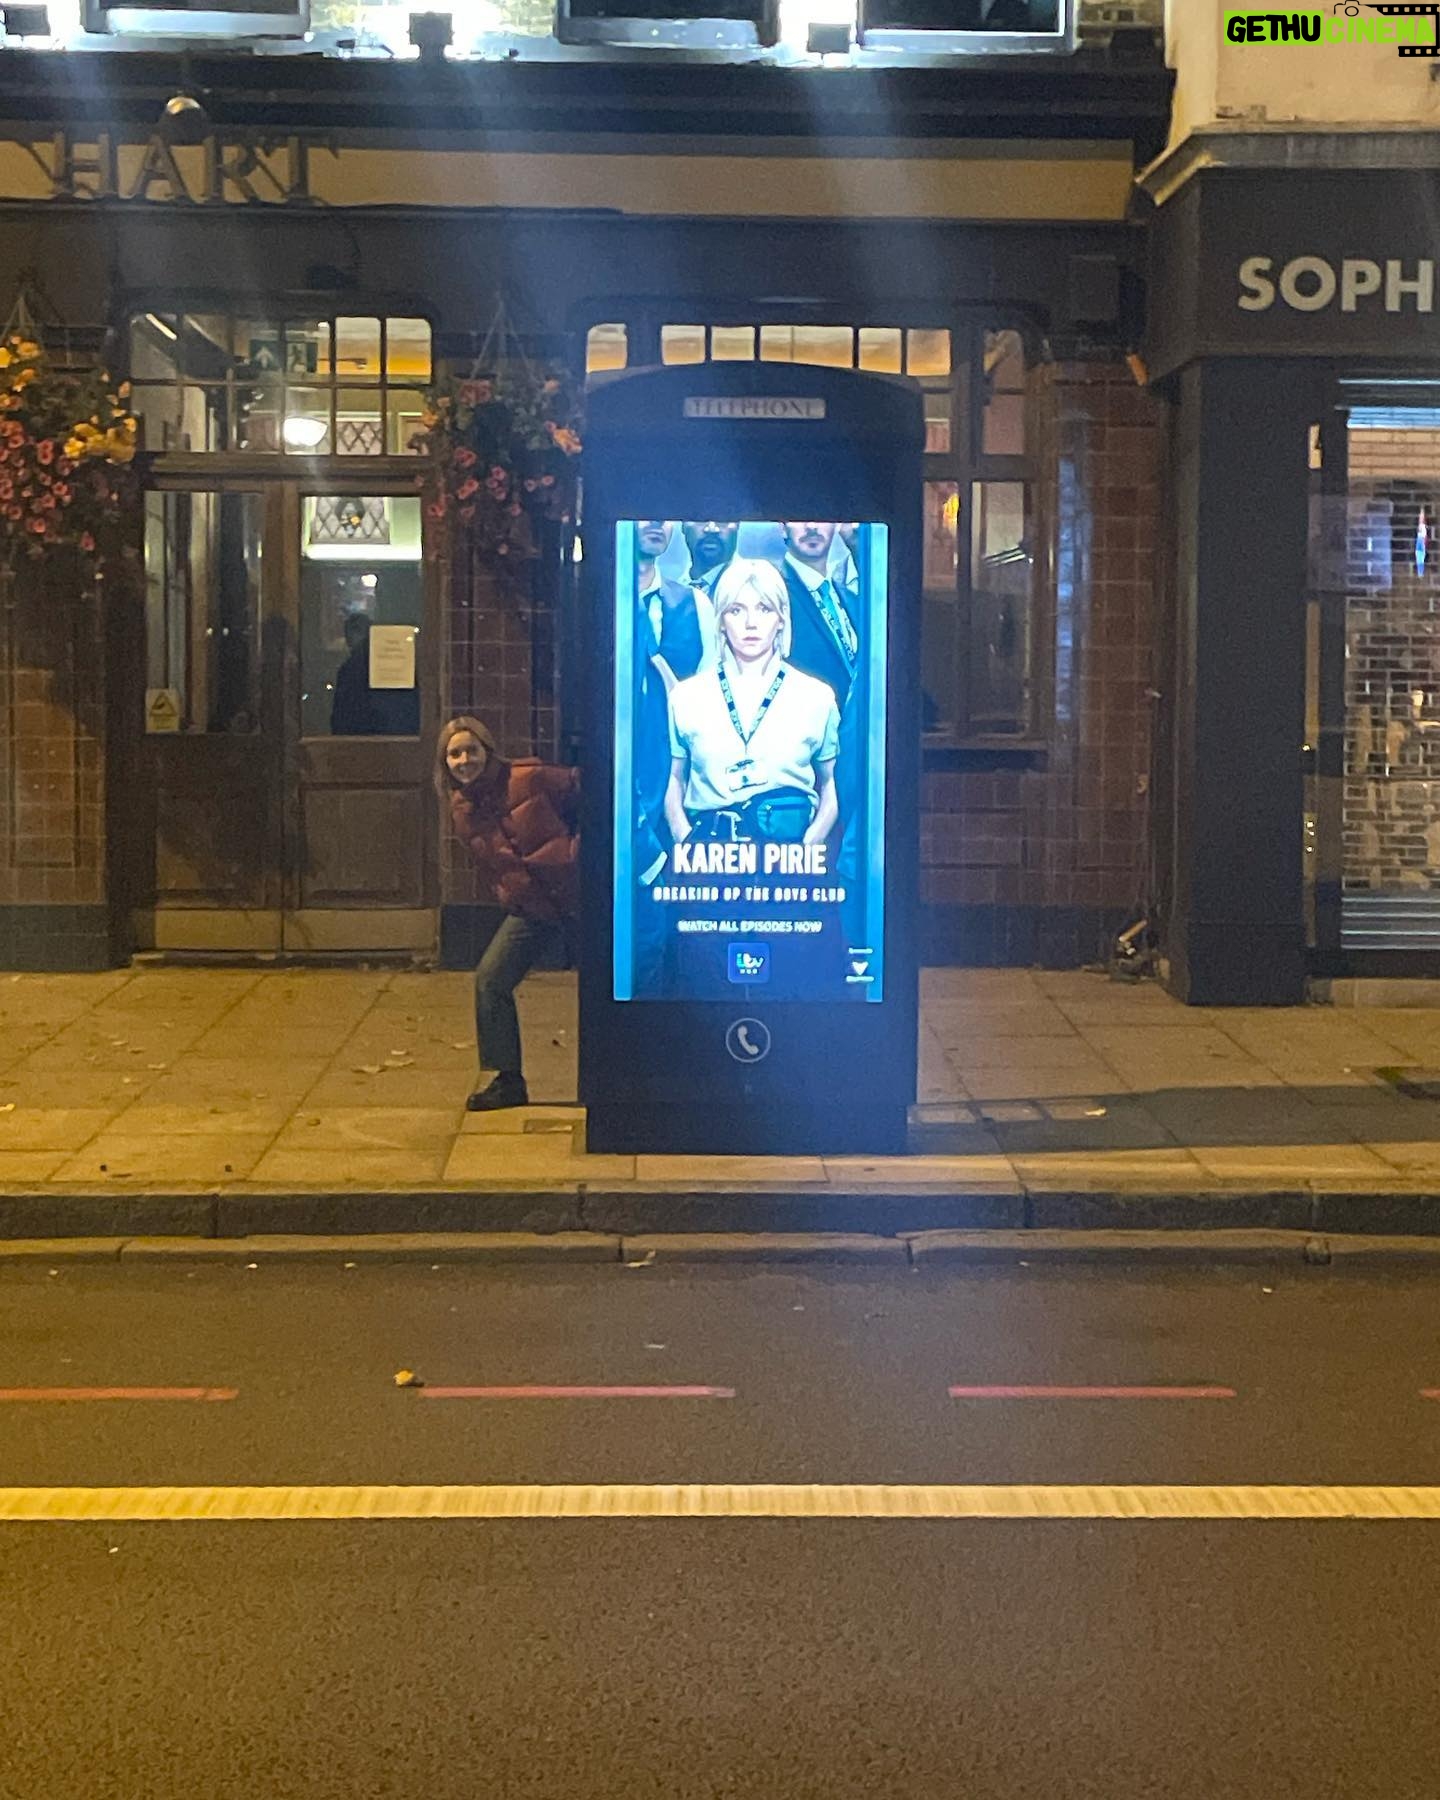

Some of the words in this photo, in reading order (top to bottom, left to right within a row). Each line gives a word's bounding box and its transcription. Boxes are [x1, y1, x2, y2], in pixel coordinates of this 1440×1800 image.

[52, 131, 338, 202] HART
[1238, 256, 1433, 312] SOPH
[673, 843, 757, 874] KAREN
[764, 844, 828, 875] PIRIE
[652, 887, 719, 902] BREAKING
[723, 887, 741, 902] UP
[745, 887, 770, 902] THE
[774, 887, 808, 903] BOYS
[813, 887, 846, 903] CLUB
[677, 920, 717, 933] WATCH
[718, 920, 739, 933] ALL
[740, 920, 793, 933] EPISODES
[794, 921, 823, 933] NOW
